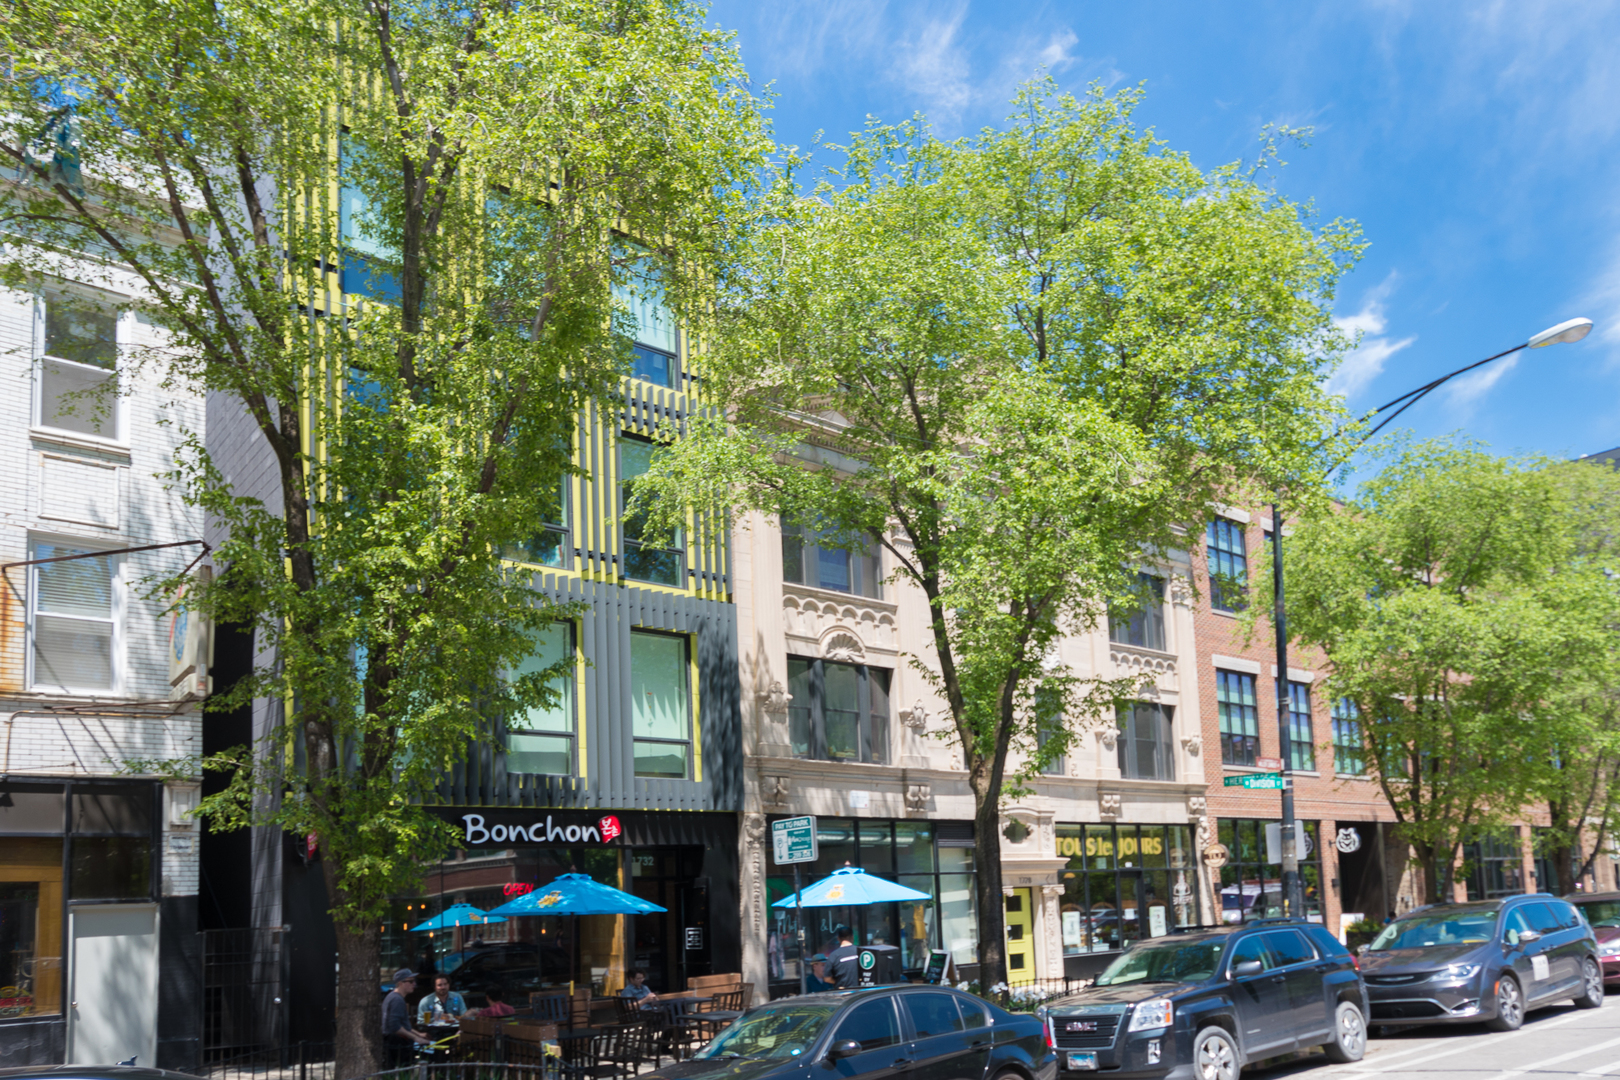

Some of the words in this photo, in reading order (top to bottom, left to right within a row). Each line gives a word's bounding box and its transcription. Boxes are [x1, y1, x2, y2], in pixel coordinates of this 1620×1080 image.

[462, 814, 600, 843] Bonchon
[1055, 837, 1096, 856] TOUS
[1117, 837, 1162, 860] JOURS
[503, 883, 534, 896] OPEN
[863, 954, 871, 967] P
[1066, 1022, 1098, 1031] GMC
